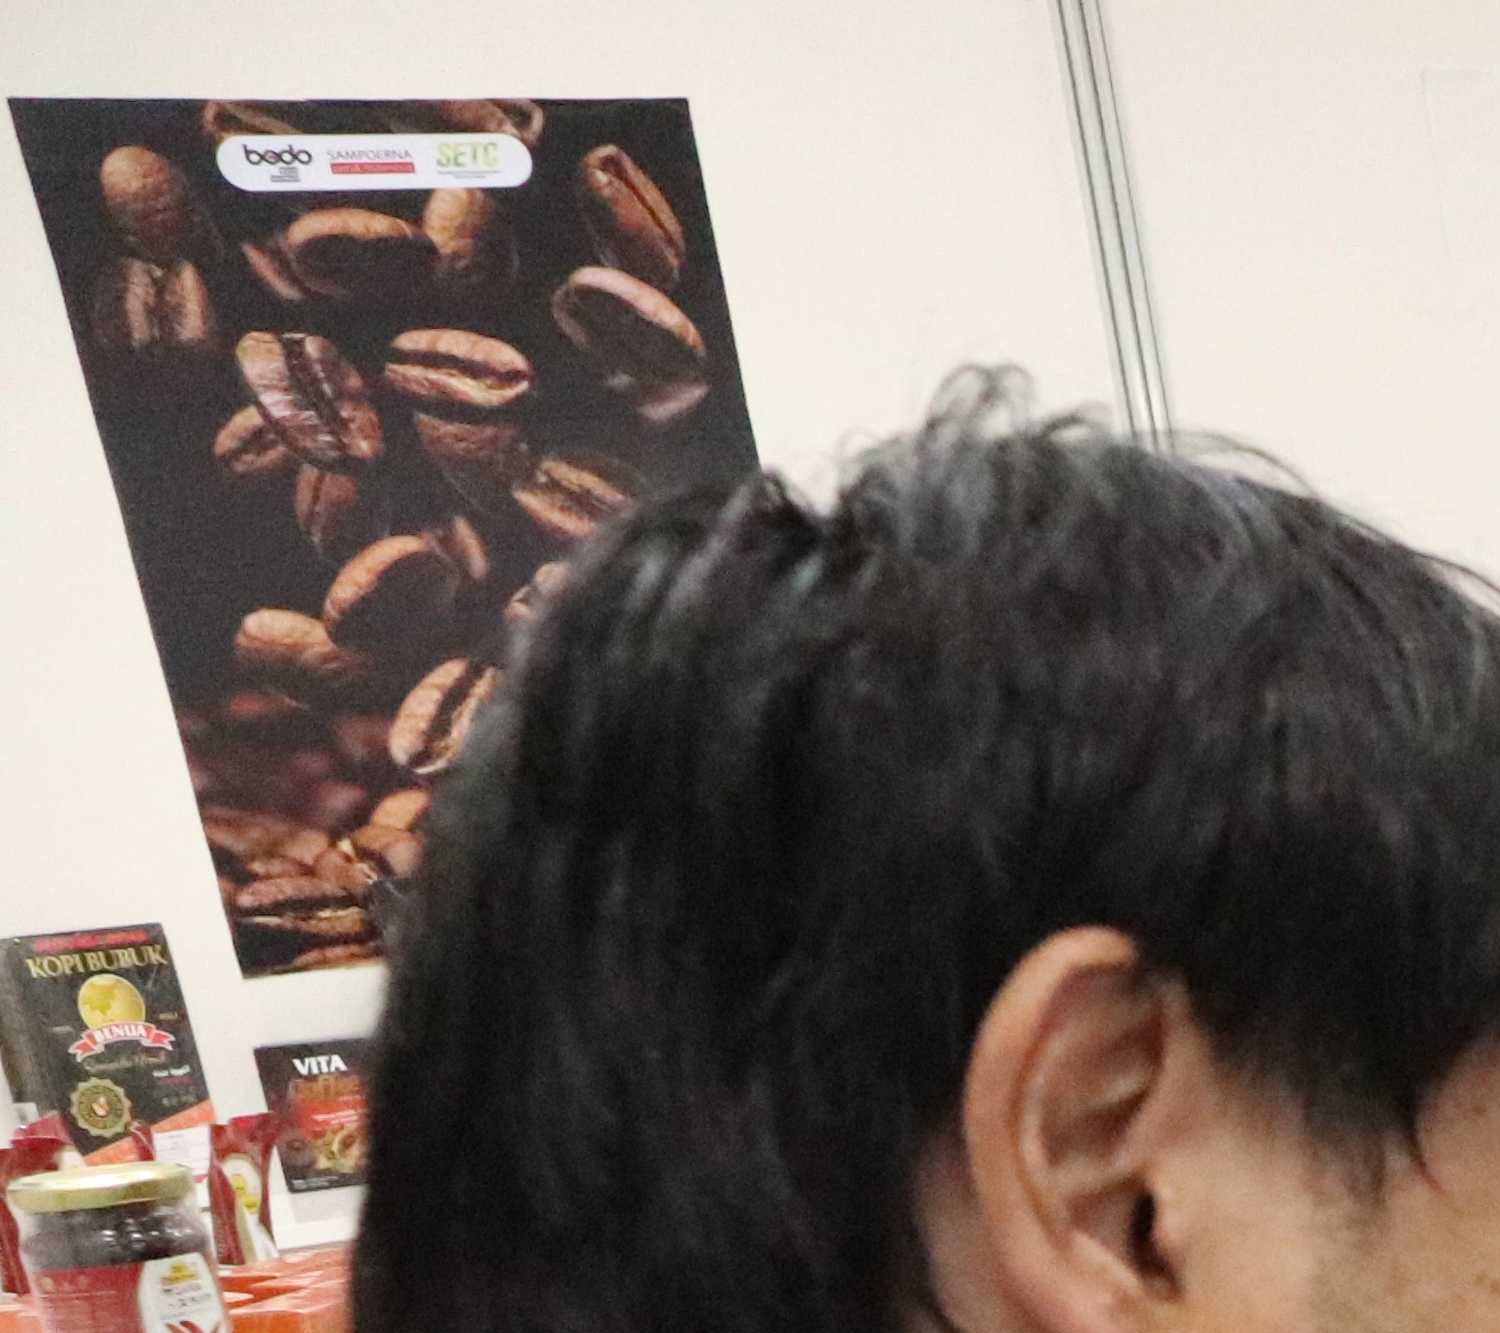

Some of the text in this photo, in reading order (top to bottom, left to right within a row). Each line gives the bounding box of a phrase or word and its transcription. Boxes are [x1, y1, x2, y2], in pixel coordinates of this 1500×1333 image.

[26, 944, 168, 979] KOPI BUBUK
[94, 1024, 148, 1039] BENUA
[292, 1054, 349, 1076] VITA
